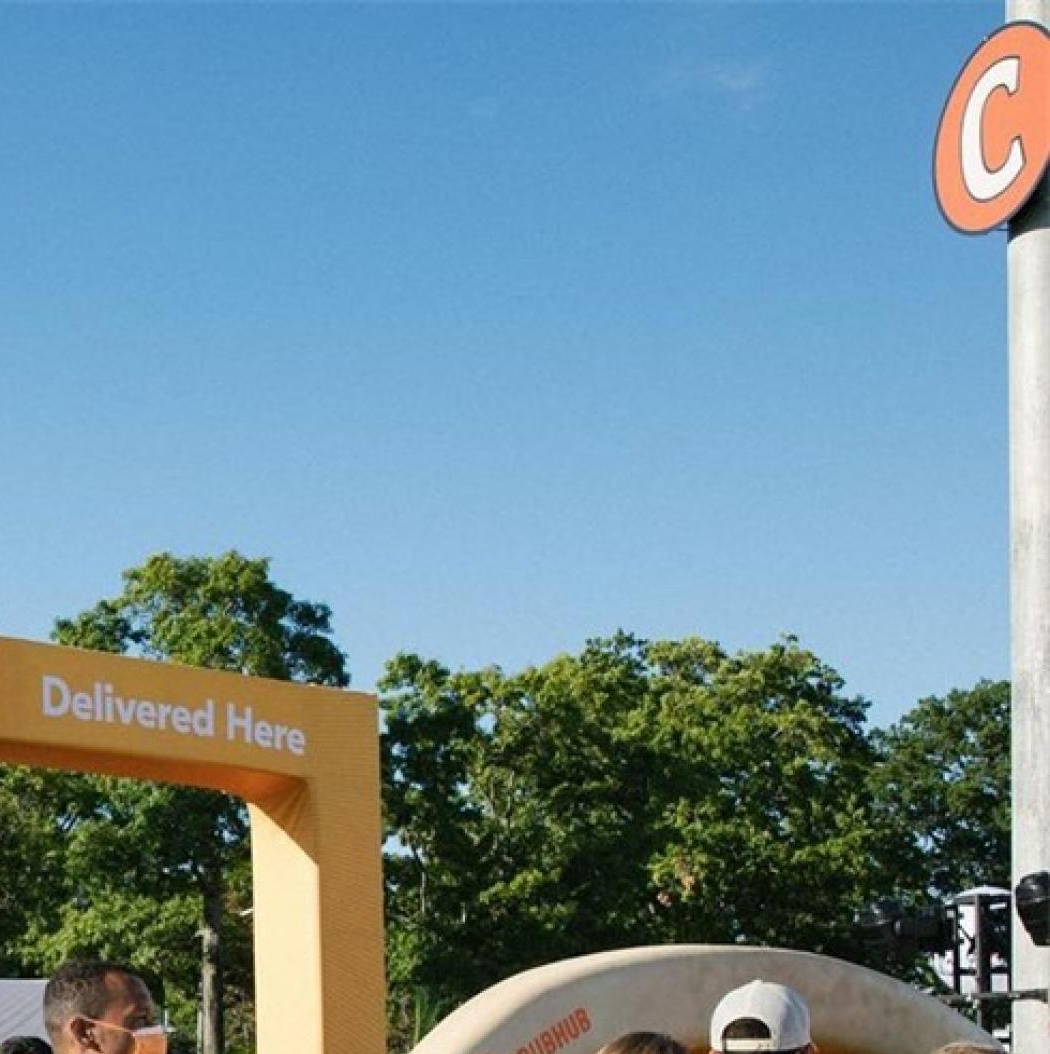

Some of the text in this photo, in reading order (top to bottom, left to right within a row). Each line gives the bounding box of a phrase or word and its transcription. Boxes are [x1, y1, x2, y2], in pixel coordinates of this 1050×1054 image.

[960, 56, 1026, 203] C
[42, 674, 307, 756] Delivered Here
